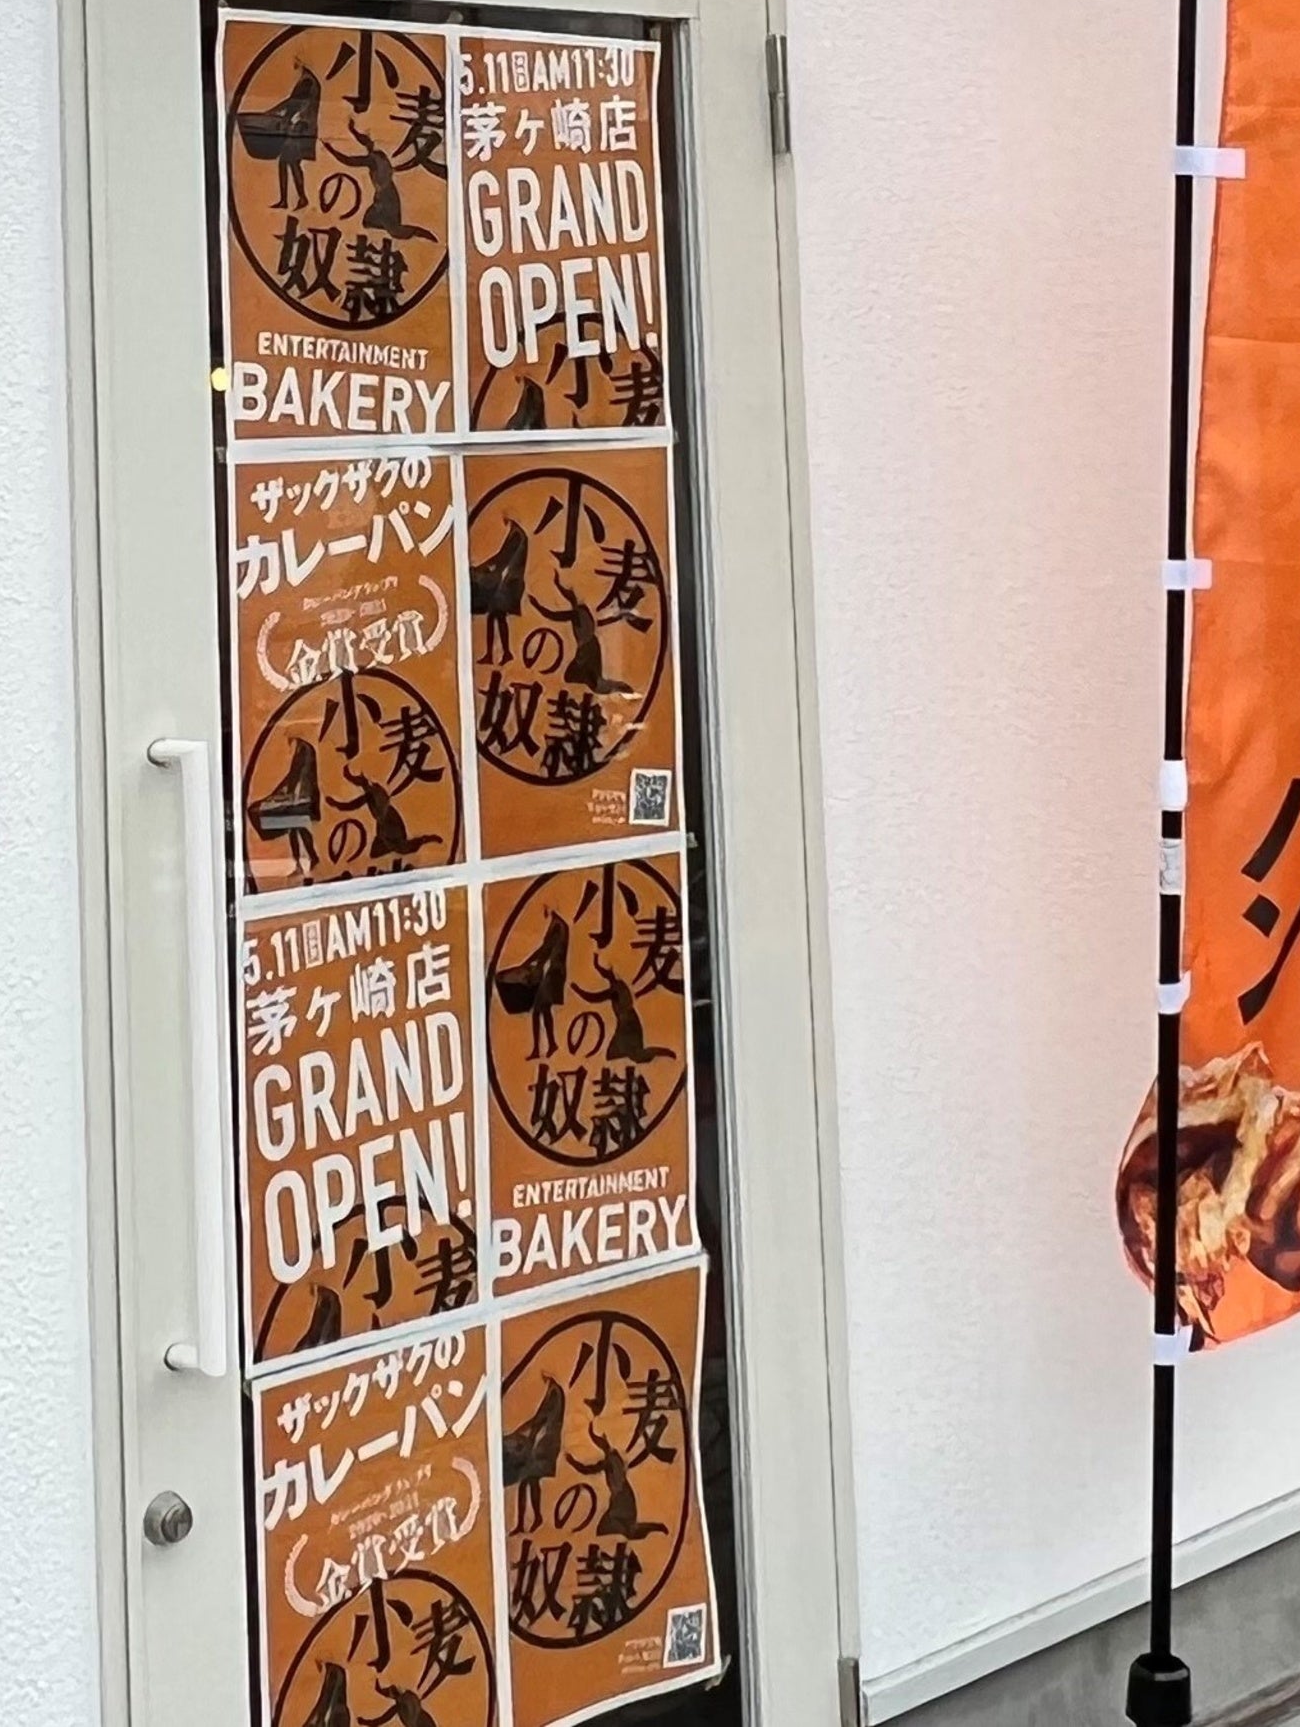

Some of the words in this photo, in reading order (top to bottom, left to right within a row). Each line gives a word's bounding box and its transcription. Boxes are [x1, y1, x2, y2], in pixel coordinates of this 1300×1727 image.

[318, 172, 362, 220] の
[466, 159, 651, 258] GRAND
[478, 251, 658, 368] OPEN!
[257, 331, 429, 370] ENTERTAINMENT
[233, 362, 451, 434] BAKERY
[249, 454, 433, 523] ザックザクの
[236, 502, 457, 600] カレーパン
[521, 626, 565, 676] の
[328, 817, 367, 865] の
[566, 1008, 605, 1060] の
[253, 1010, 465, 1162] GRAND
[263, 1111, 473, 1285] OPEN!
[511, 1165, 671, 1210] ENTERTAINMENT
[491, 1192, 688, 1278] BAKERY
[276, 1328, 468, 1445] ザックザクの
[262, 1372, 489, 1531] カレーパン
[553, 1481, 597, 1532] の
